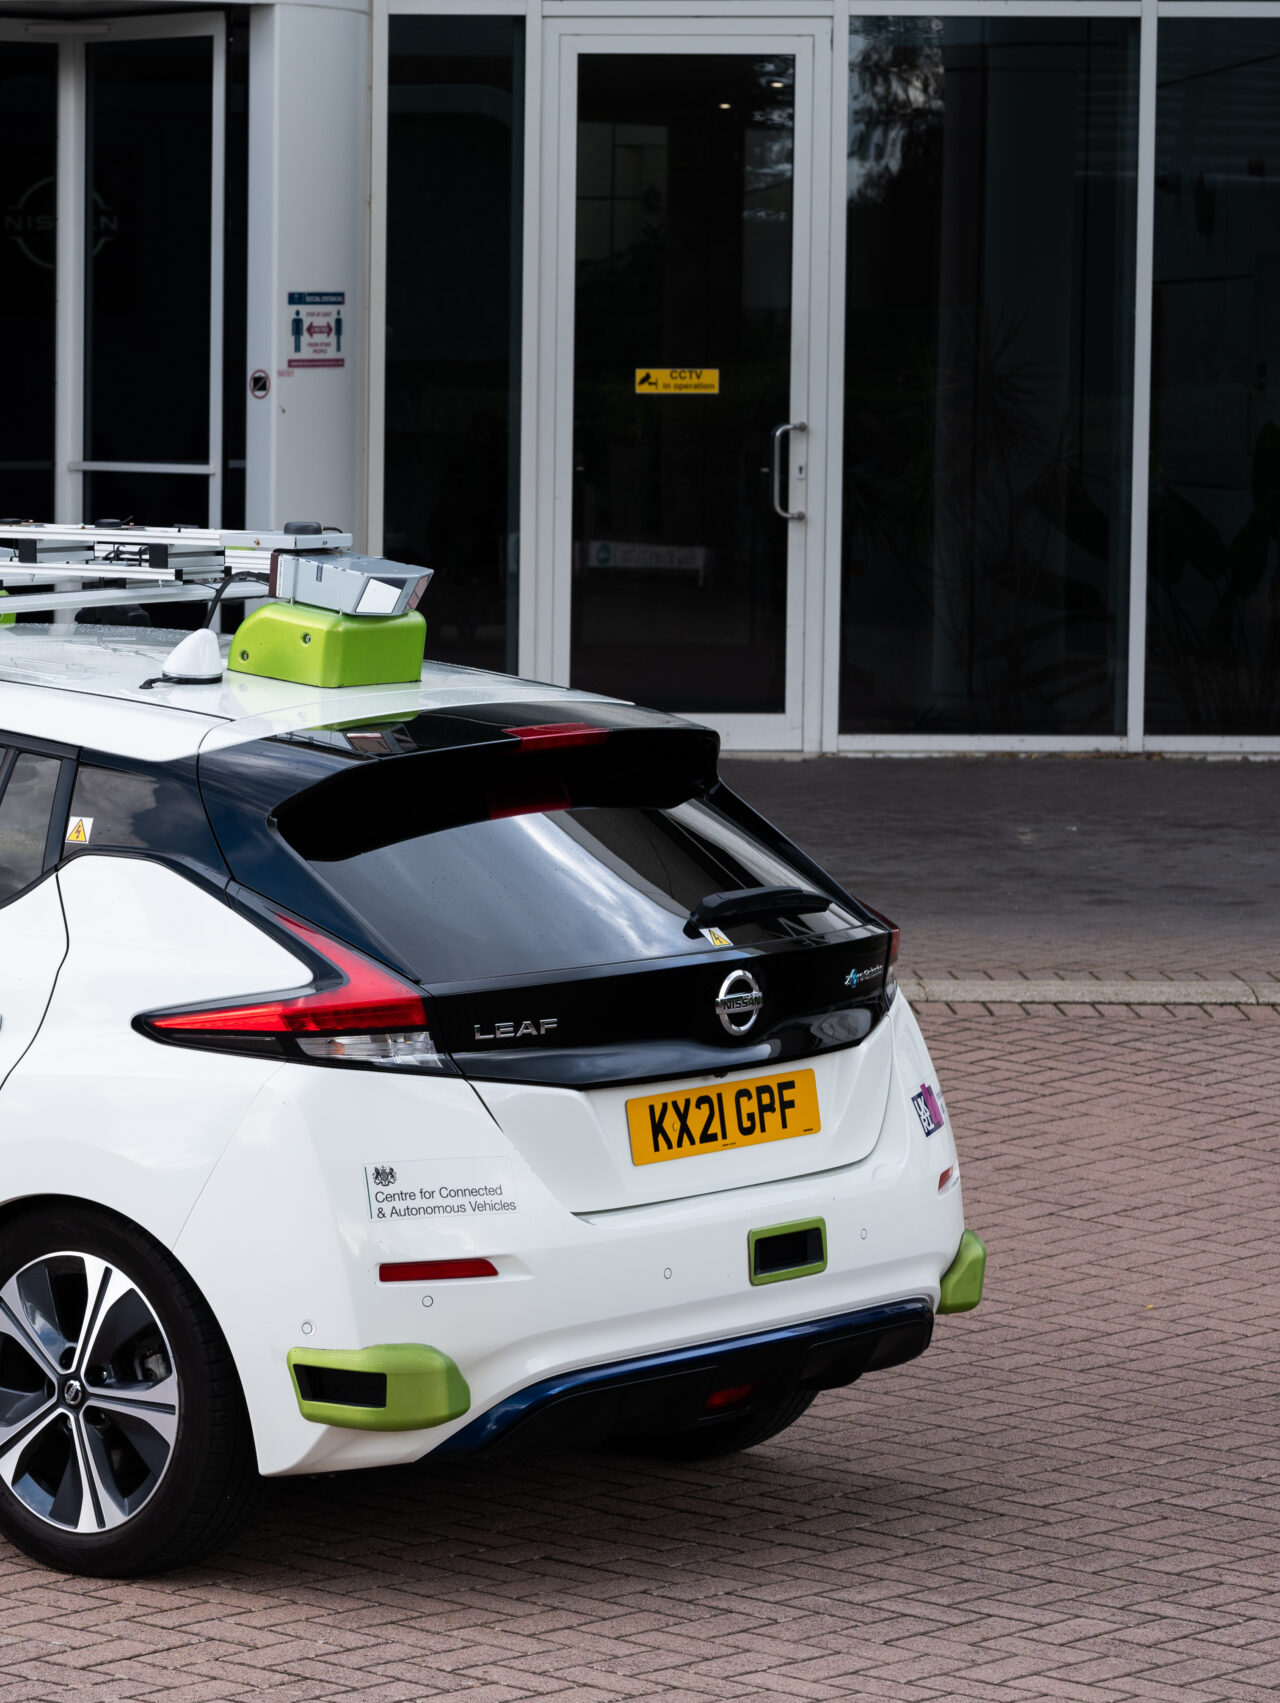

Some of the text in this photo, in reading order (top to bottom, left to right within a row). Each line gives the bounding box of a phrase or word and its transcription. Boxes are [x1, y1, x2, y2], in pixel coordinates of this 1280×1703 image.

[3, 215, 119, 232] NISN
[670, 369, 703, 380] CCTV
[673, 382, 715, 391] operation
[723, 996, 761, 1010] NISSAN
[474, 1018, 558, 1040] LEAF
[649, 1080, 796, 1153] KX21 GPF
[375, 1184, 503, 1204] Centre for Connected
[377, 1200, 517, 1219] & Autonomous Vehicles
